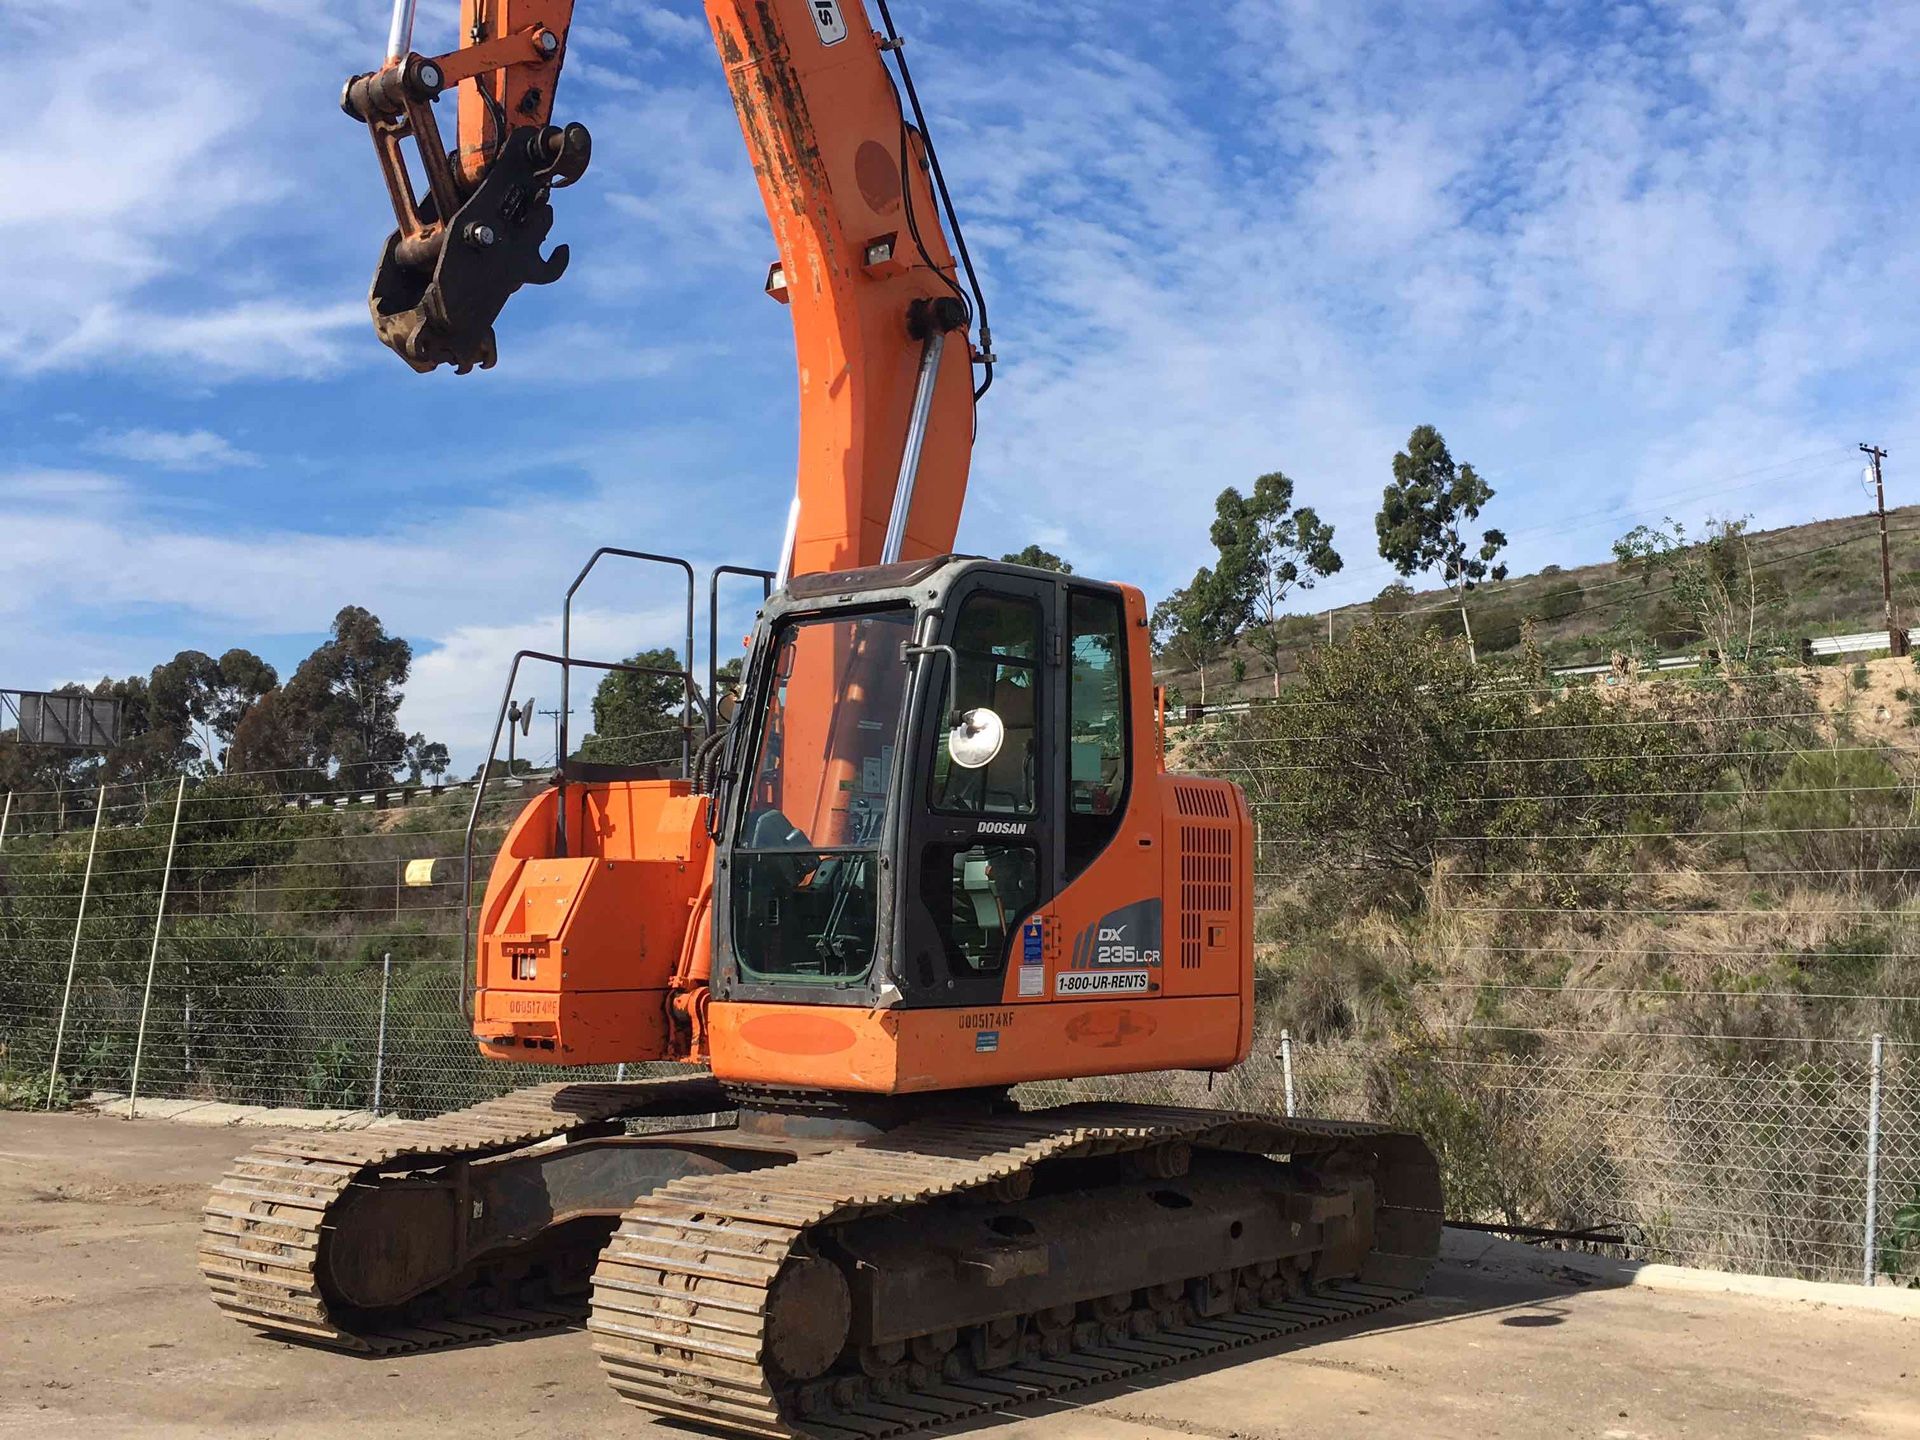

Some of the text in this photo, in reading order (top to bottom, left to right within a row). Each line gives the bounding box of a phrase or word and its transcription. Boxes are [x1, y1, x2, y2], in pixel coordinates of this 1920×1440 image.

[977, 821, 1027, 834] DOOSAN
[1098, 924, 1128, 941] DX
[1059, 974, 1147, 991] 1-800-UR-RENTS
